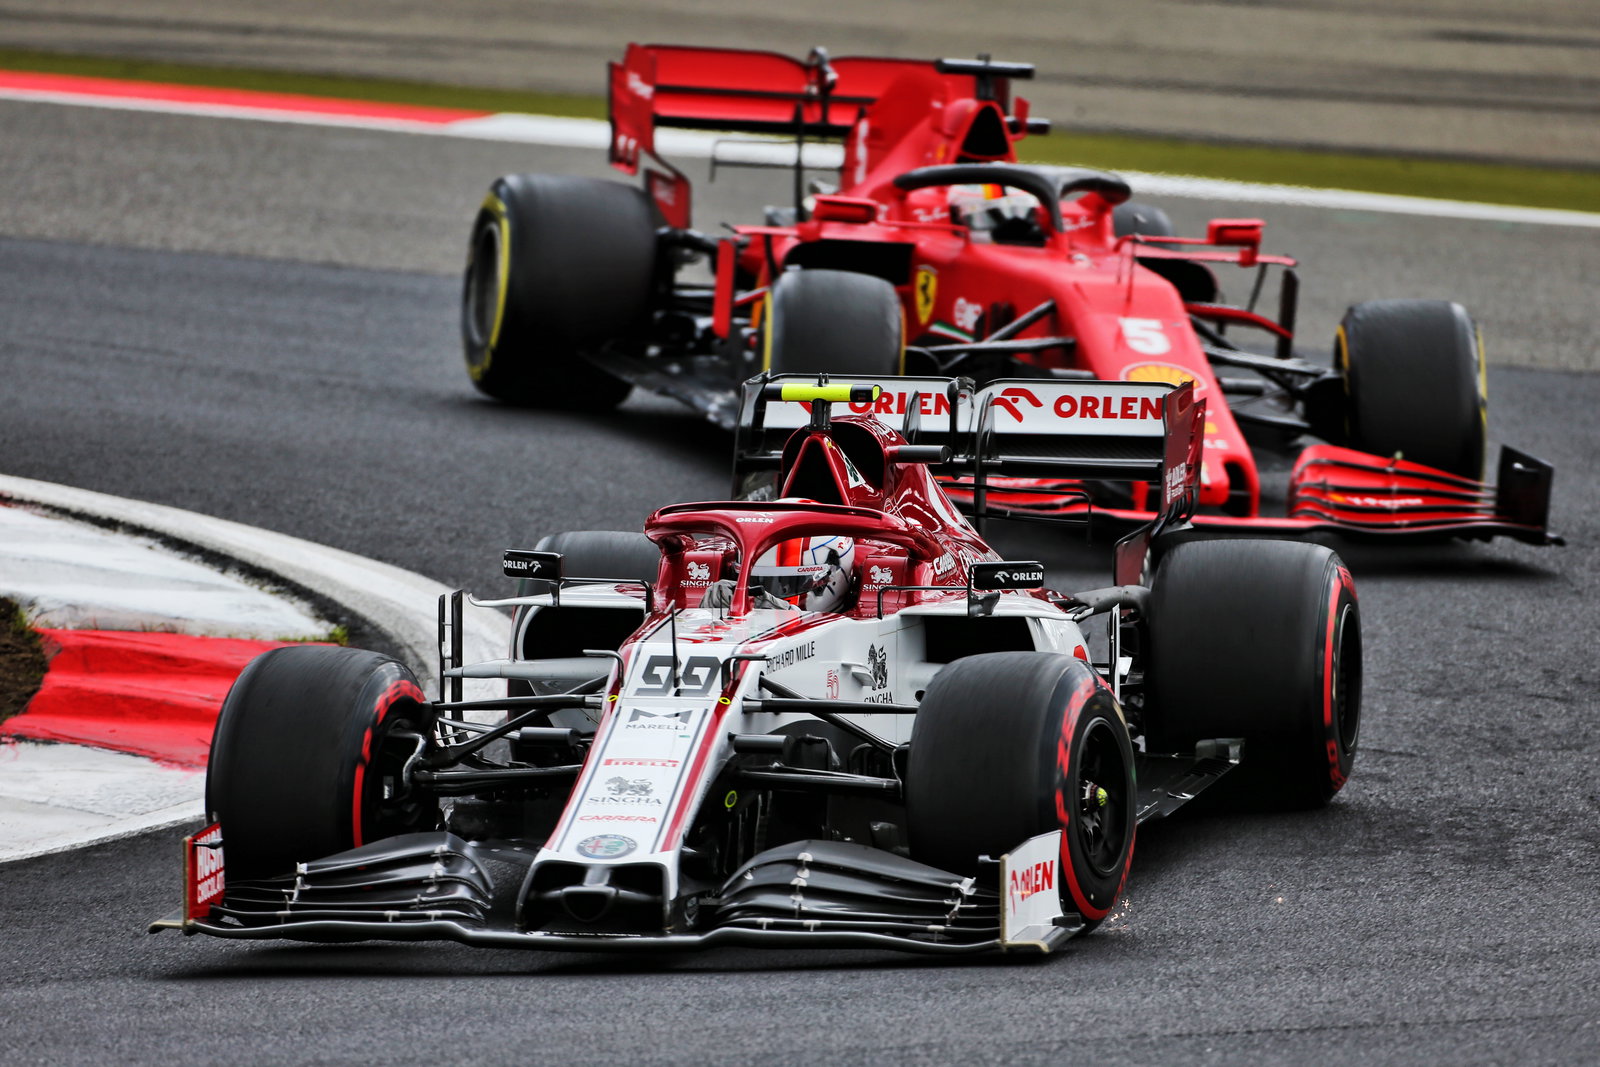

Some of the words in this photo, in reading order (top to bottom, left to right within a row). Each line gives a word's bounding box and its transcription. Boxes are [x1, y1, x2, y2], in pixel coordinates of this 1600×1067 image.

[1119, 317, 1171, 355] 5
[1053, 395, 1162, 420] ORLEN
[503, 560, 528, 570] ORLEN
[1012, 572, 1043, 581] ORLEN
[766, 649, 794, 675] RICHARD
[795, 641, 816, 662] MILLE
[633, 655, 722, 697] 99
[603, 758, 680, 768] PIRELLI
[578, 815, 657, 823] CARRERA
